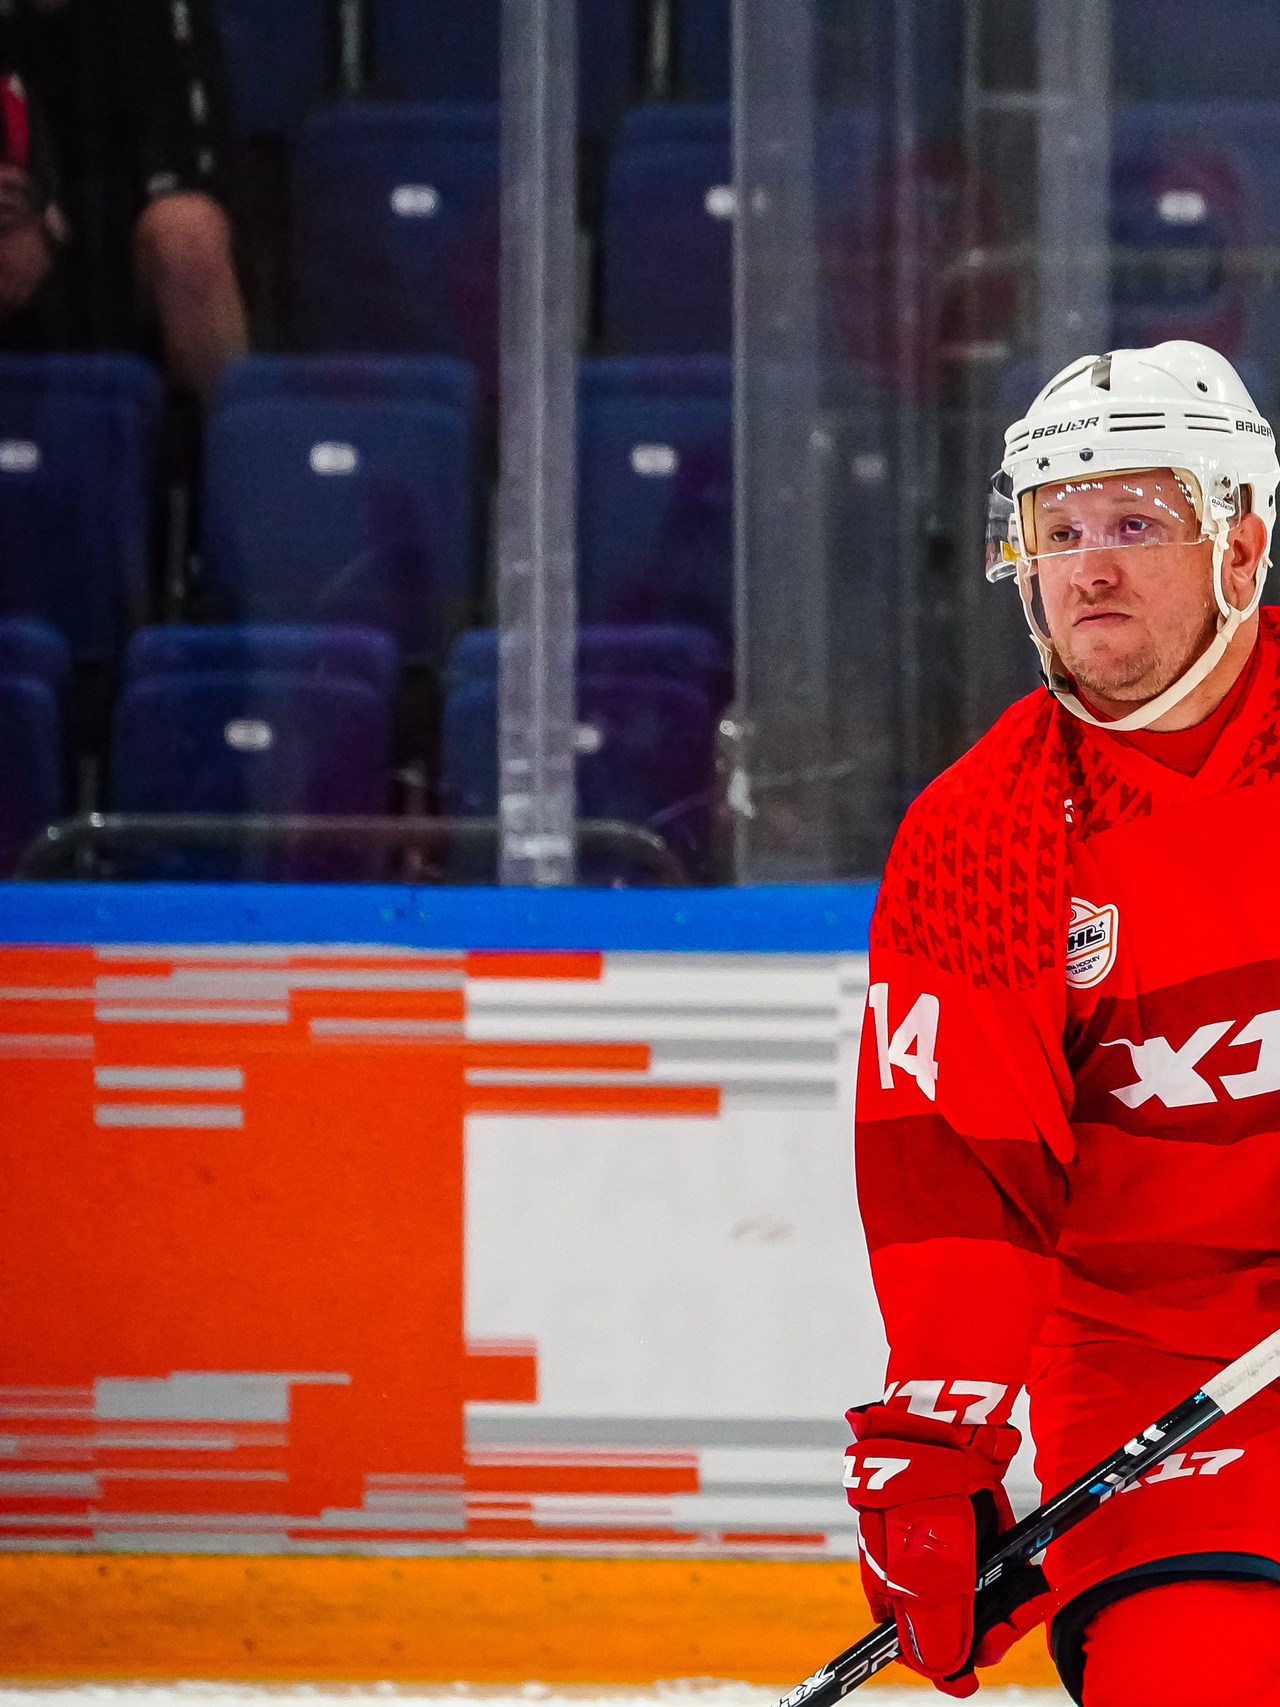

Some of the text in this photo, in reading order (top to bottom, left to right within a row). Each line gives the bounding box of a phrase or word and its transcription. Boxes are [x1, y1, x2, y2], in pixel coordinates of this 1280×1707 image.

[1031, 416, 1099, 439] BAUER
[1236, 420, 1272, 439] BAUER
[1067, 925, 1105, 953] HL
[868, 983, 939, 1101] 14
[1121, 1448, 1245, 1494] 17
[840, 1637, 899, 1696] PR
